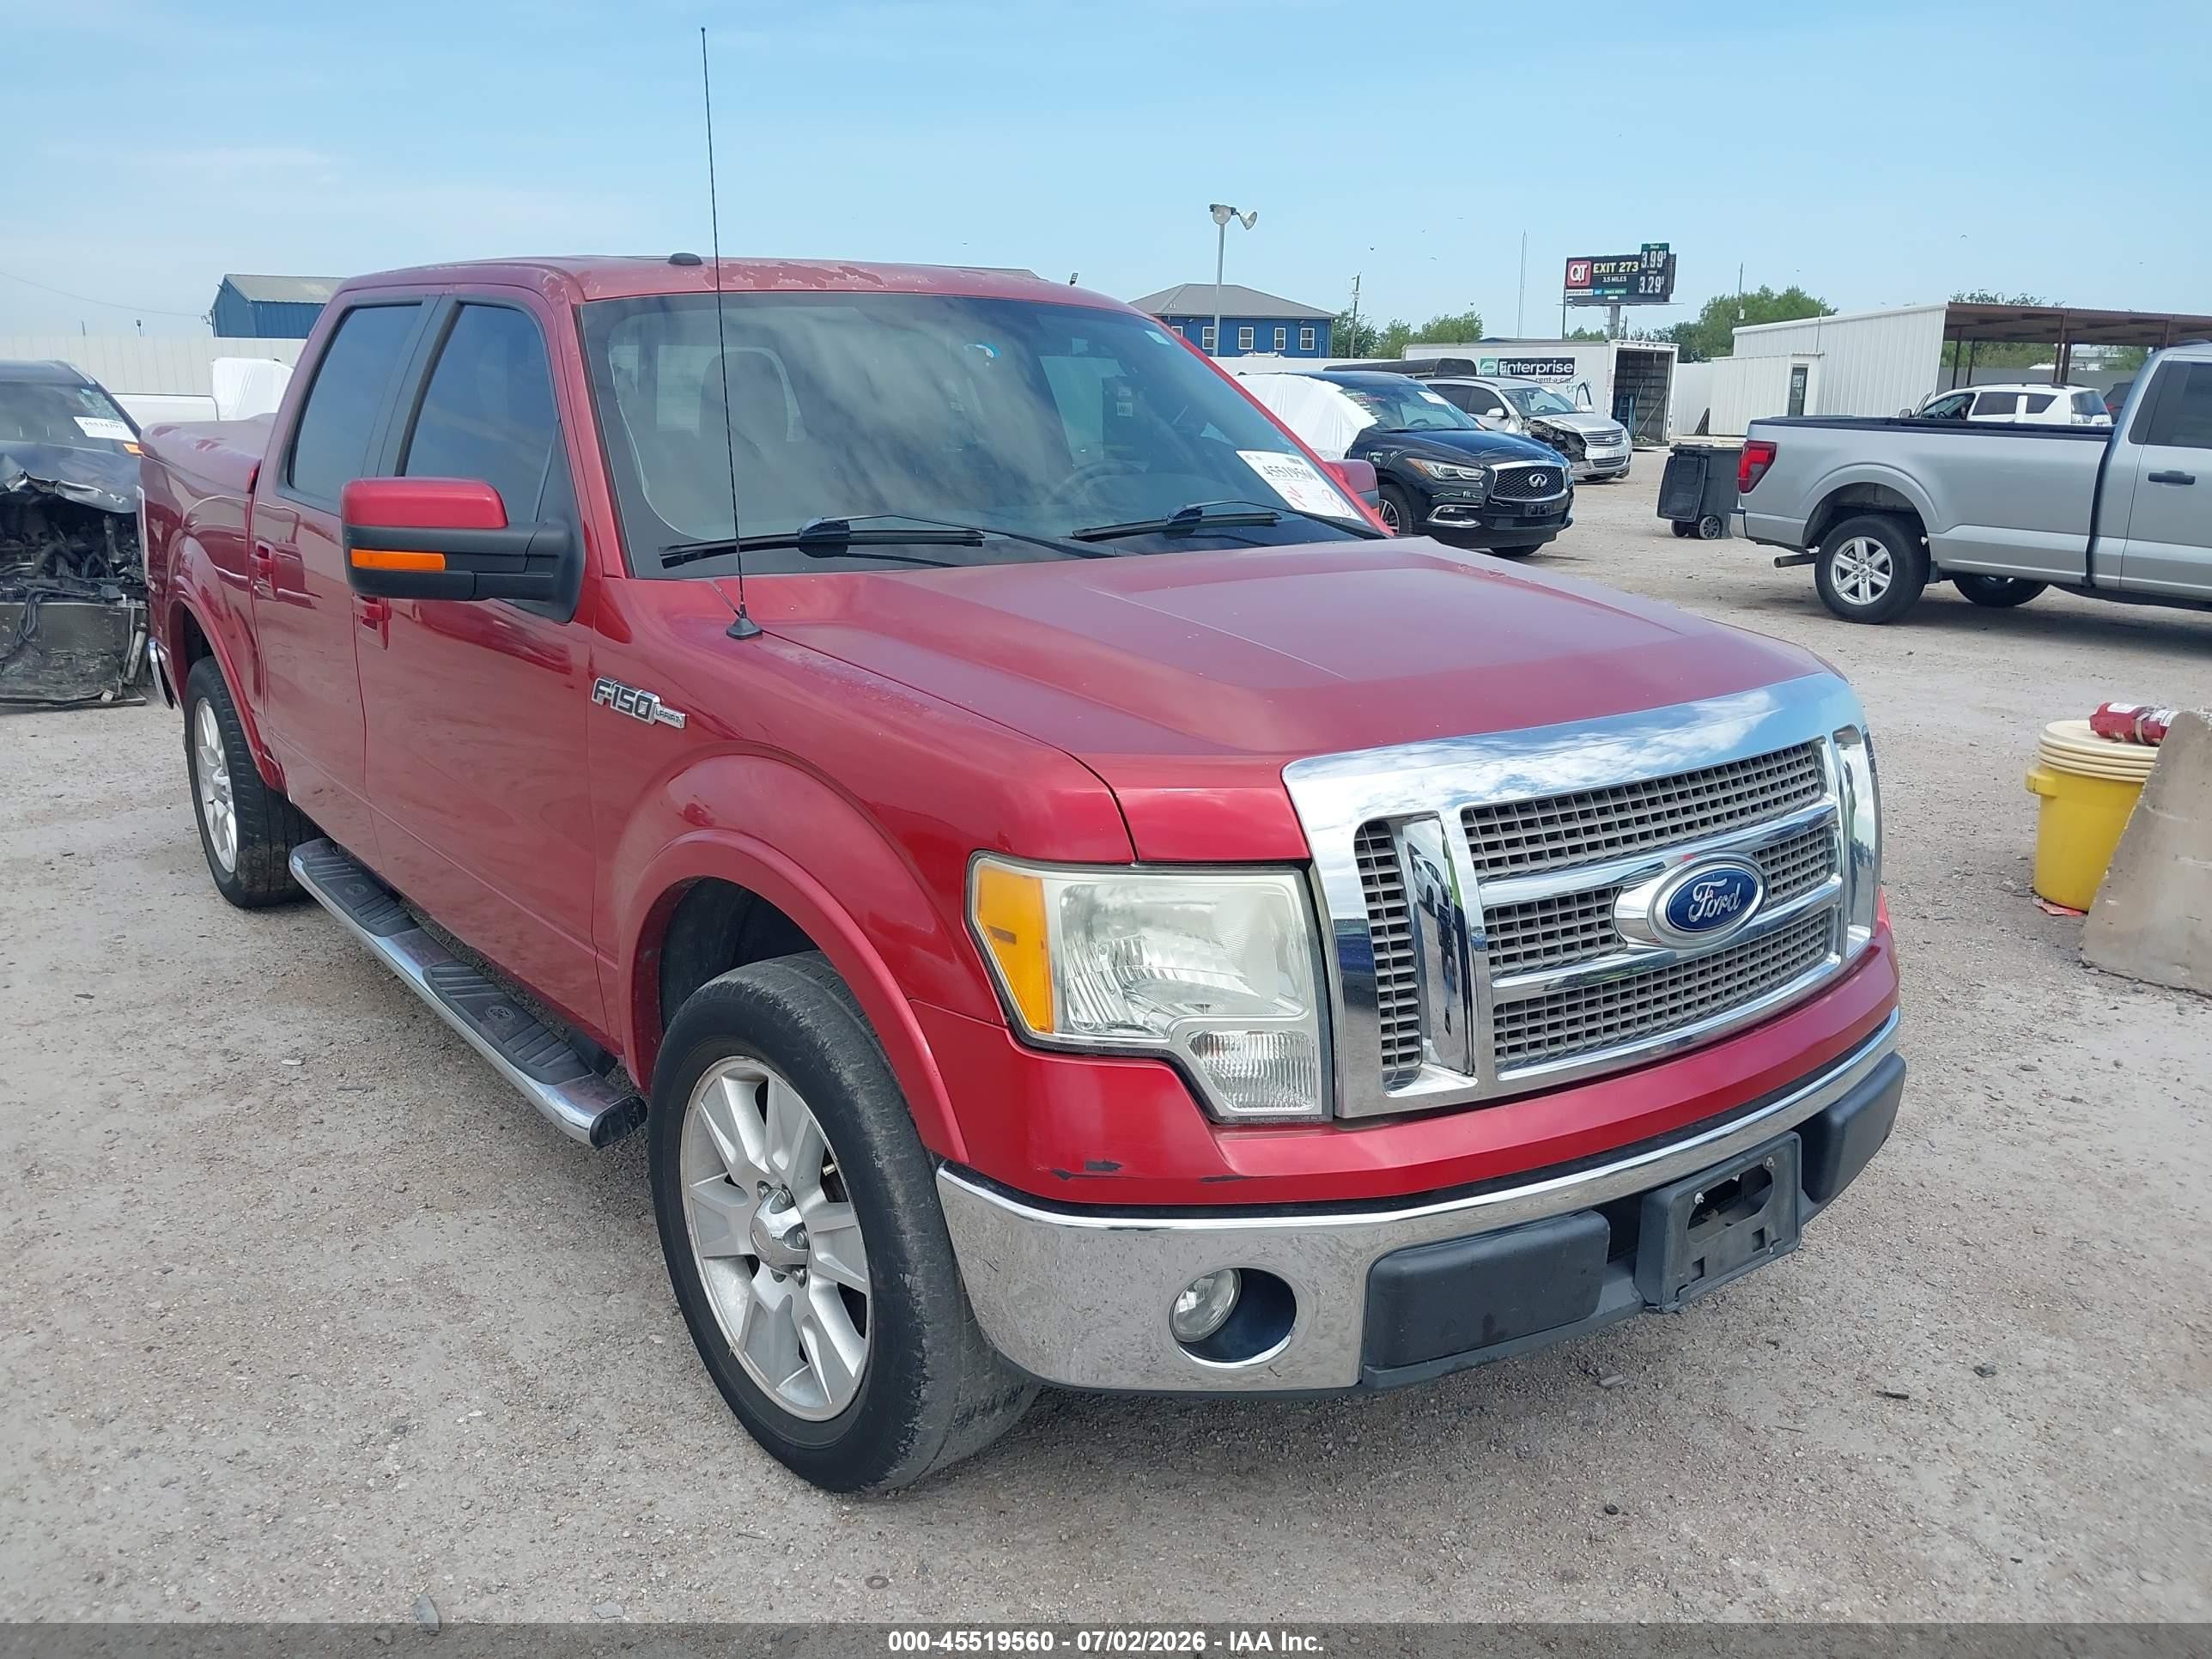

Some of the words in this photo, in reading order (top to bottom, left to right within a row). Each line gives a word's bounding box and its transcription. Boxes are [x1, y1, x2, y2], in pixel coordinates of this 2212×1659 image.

[1570, 264, 1588, 283] QT
[1593, 262, 1616, 273] EXIT
[1619, 261, 1639, 272] 273
[1498, 360, 1574, 376] Enterprise
[1566, 378, 1592, 393] trk
[1687, 878, 1741, 922] Ford
